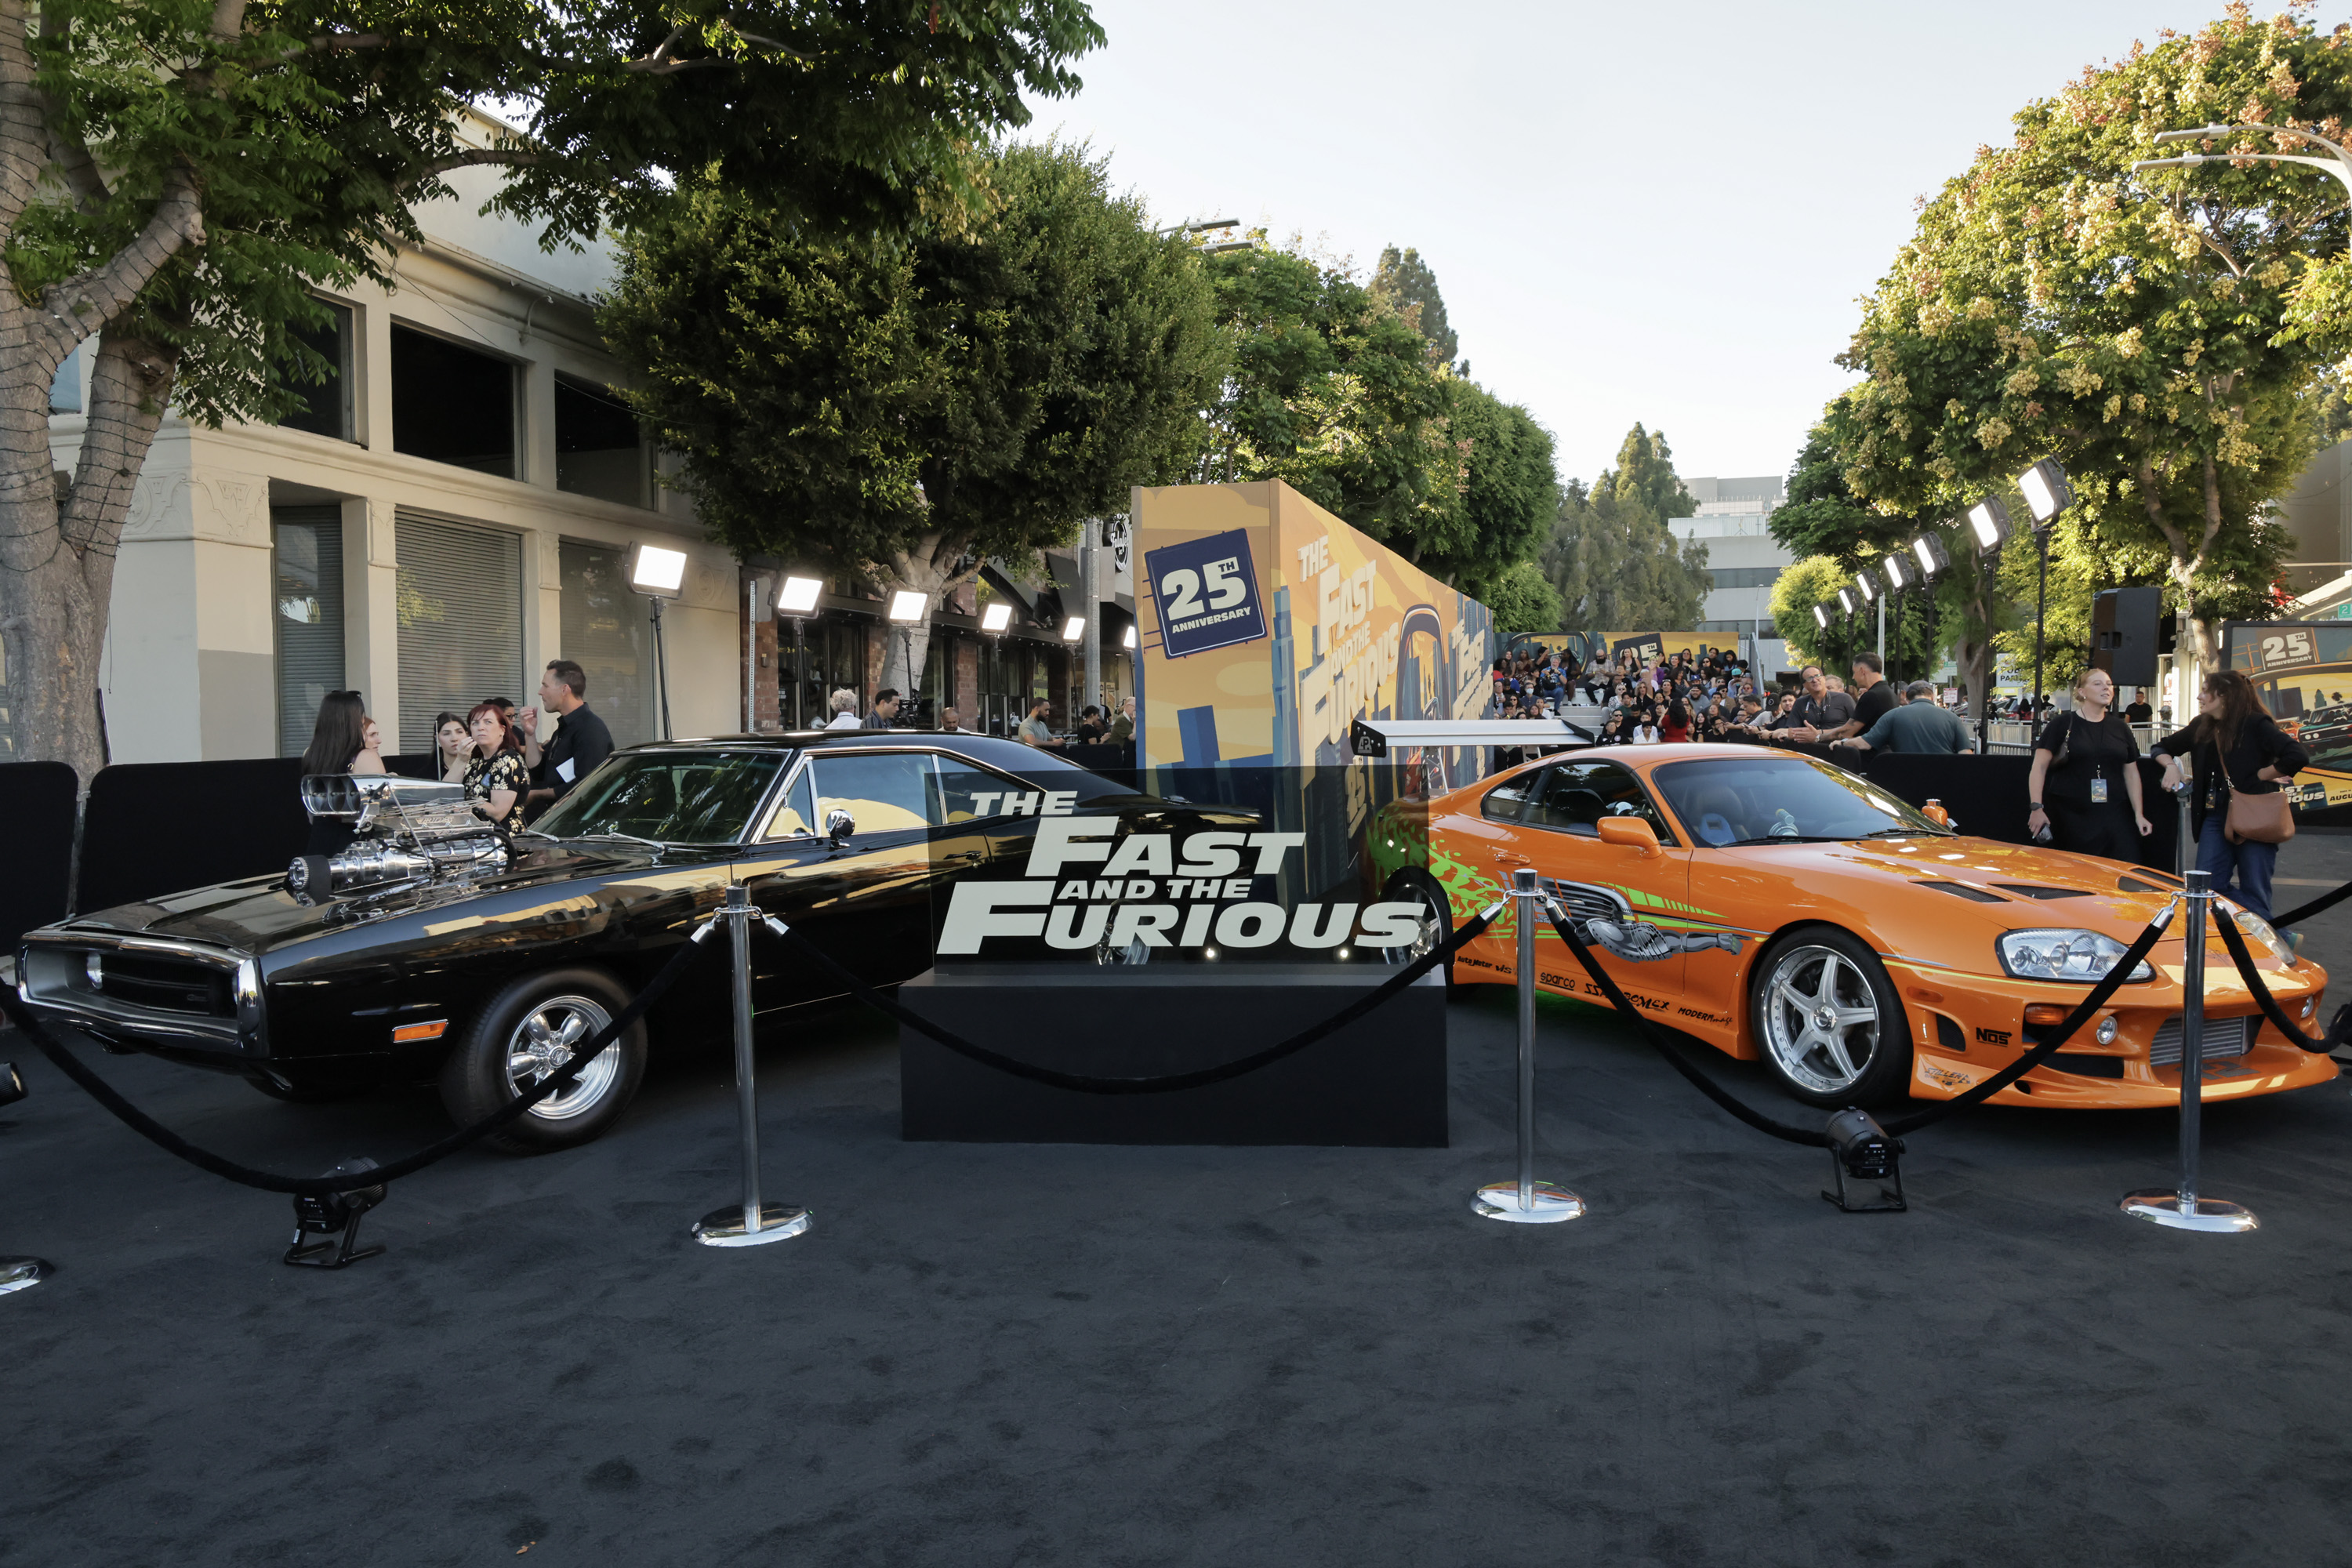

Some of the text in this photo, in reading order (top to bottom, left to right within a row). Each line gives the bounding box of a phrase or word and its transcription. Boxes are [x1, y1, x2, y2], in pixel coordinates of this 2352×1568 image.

[1298, 535, 1328, 583] THE
[1172, 606, 1251, 634] ANNIVERSARY
[1317, 560, 1376, 656] FAST
[2341, 605, 2349, 614] 2
[1331, 621, 1370, 677] AND THE
[2267, 655, 2313, 668] ANNIVERSARY
[1300, 622, 1399, 790] FURIOUS
[969, 791, 1078, 815] THE
[1025, 816, 1307, 877] FAST
[1056, 879, 1251, 900] AND THE
[936, 880, 1427, 955] FURIOUS
[1540, 971, 1576, 989] sparco
[1976, 1027, 2013, 1045] NOS
